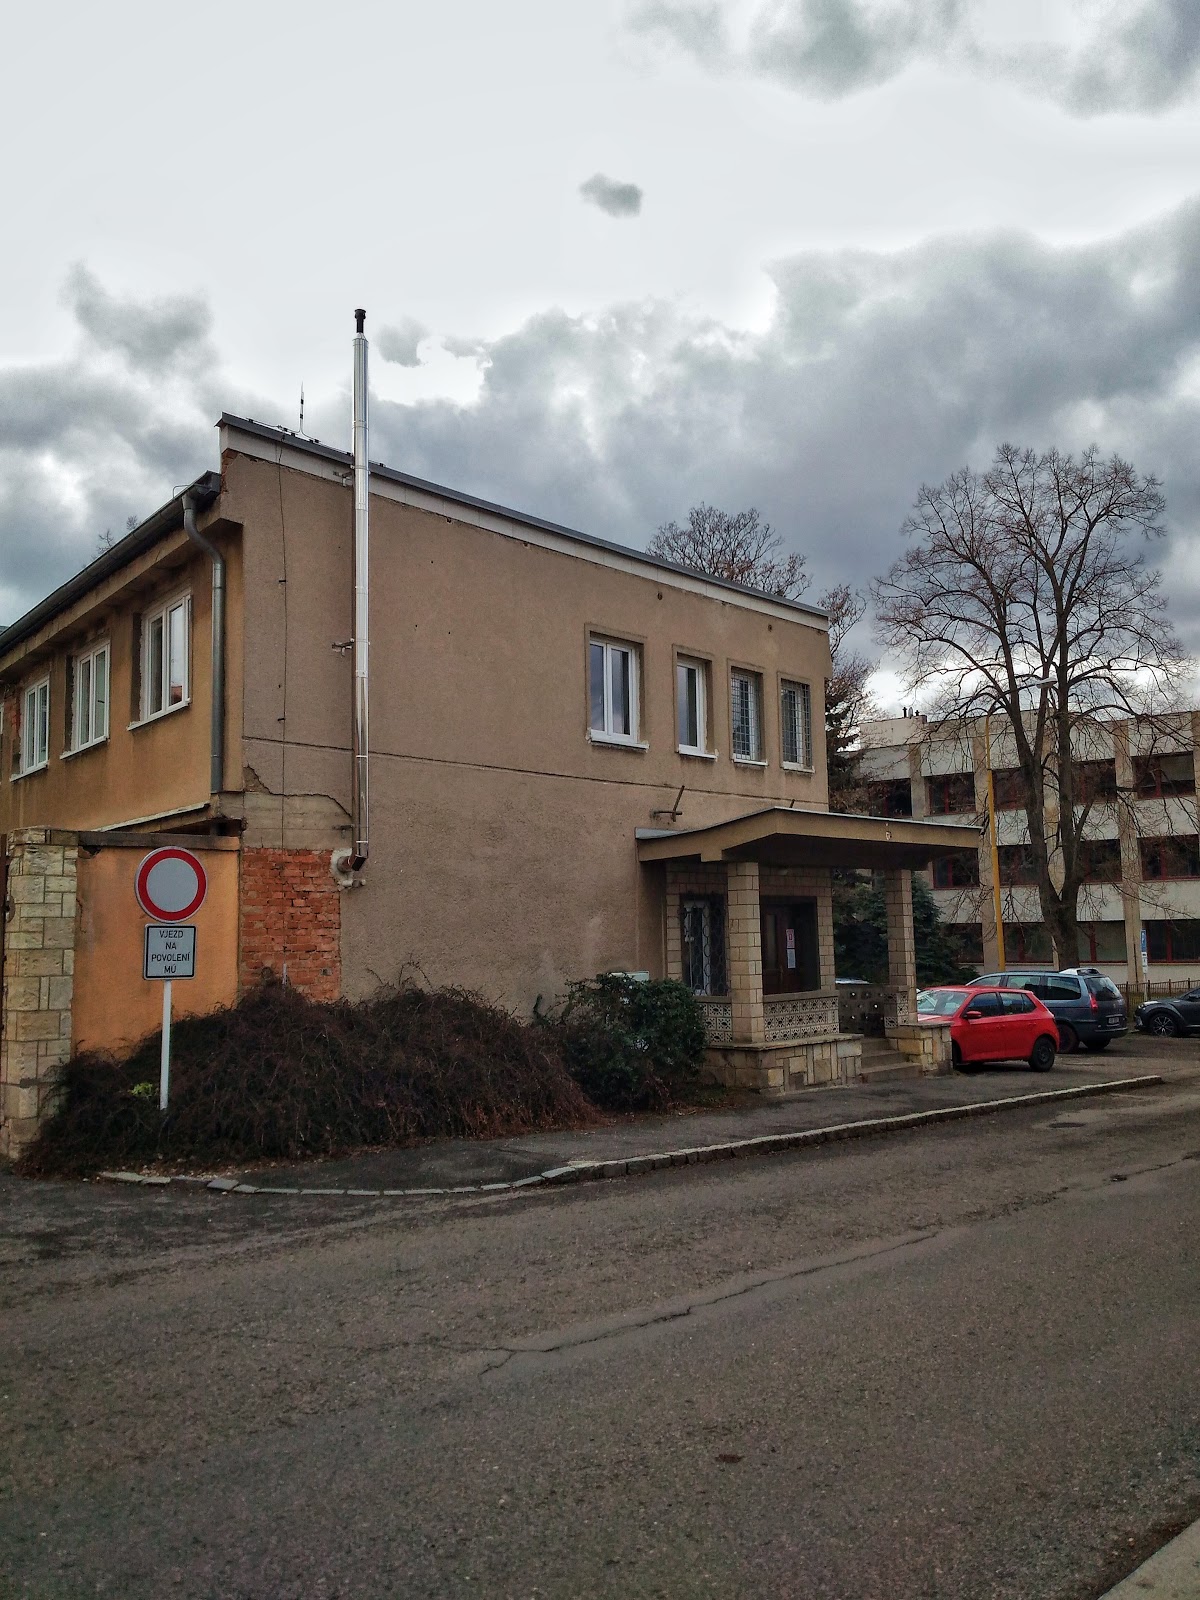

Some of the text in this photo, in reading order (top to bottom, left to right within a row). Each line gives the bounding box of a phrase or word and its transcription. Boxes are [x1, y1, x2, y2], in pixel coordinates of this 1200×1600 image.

[159, 930, 184, 939] VJEZD
[165, 942, 177, 950] NA
[151, 951, 191, 962] POVOLENÍ
[164, 964, 177, 974] MÚ
